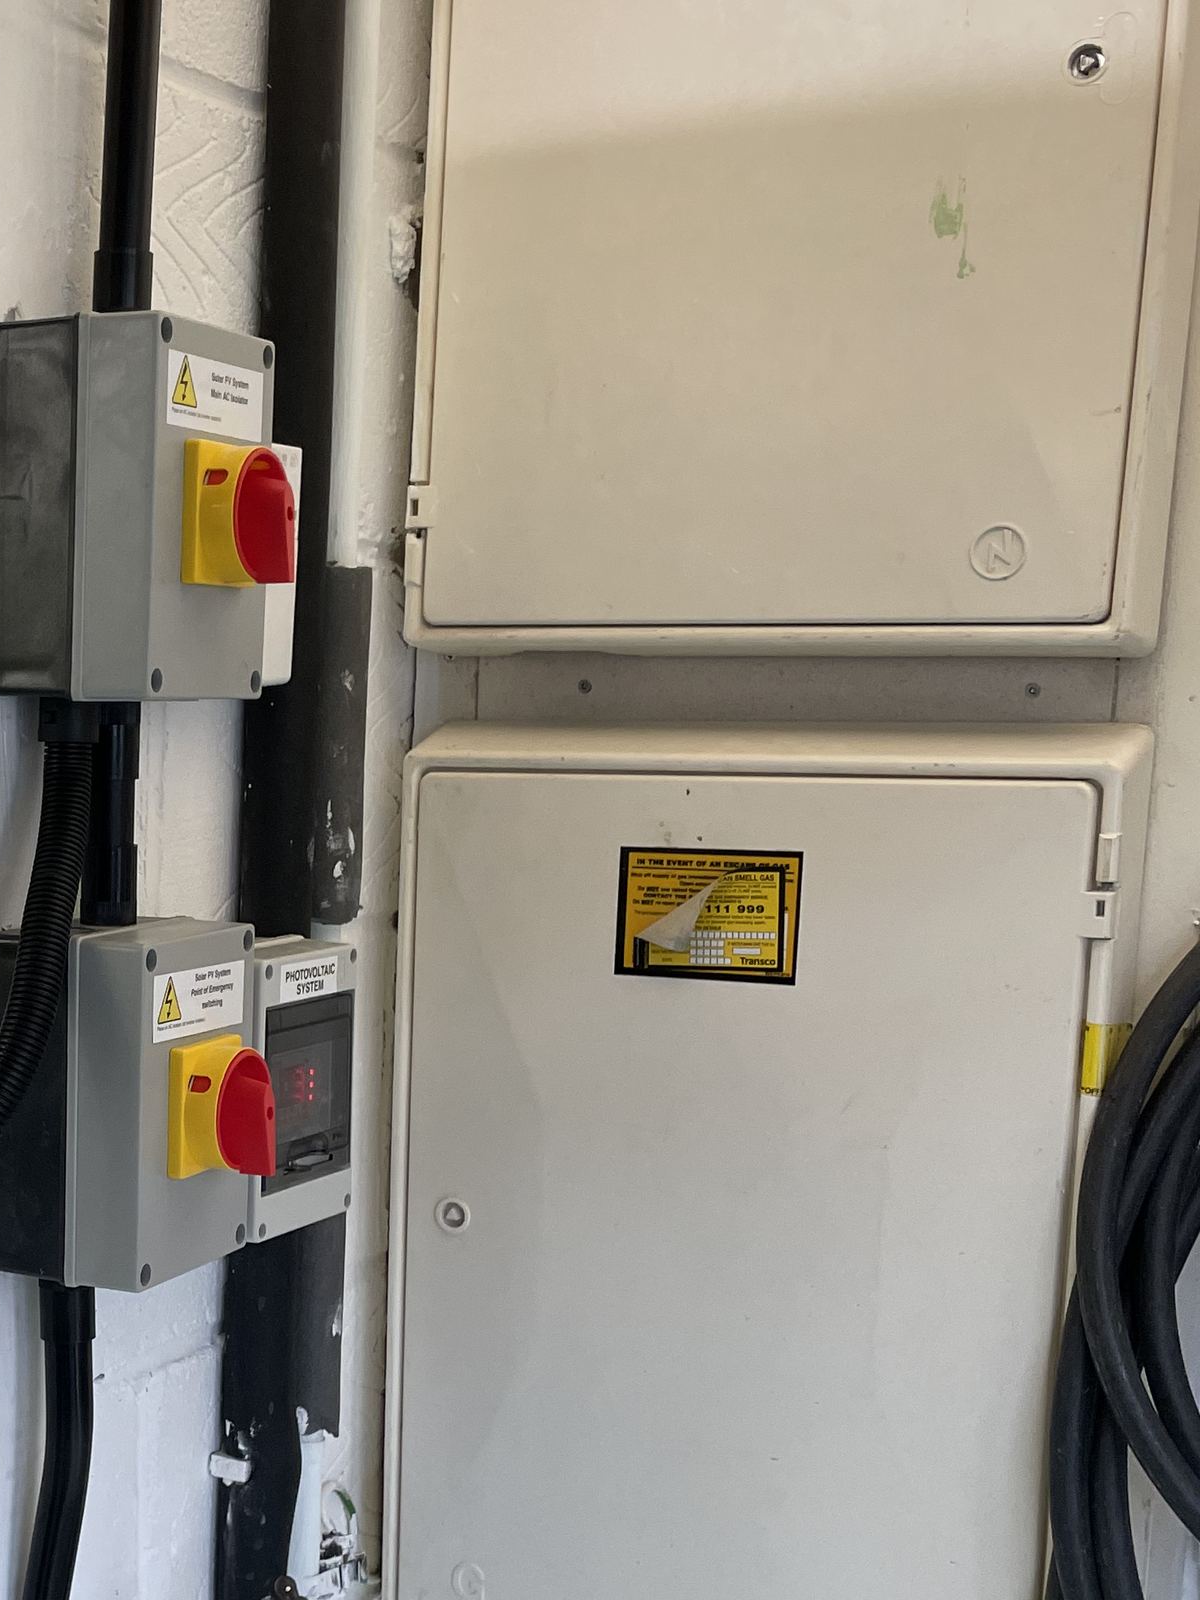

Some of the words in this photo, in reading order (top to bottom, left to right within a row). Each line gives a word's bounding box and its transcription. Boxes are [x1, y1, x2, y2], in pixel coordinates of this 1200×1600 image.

[737, 904, 764, 914] 999
[740, 956, 776, 966] Transco
[215, 968, 232, 980] System
[285, 963, 336, 983] PHOTOVOLTAIC
[208, 982, 234, 994] Emergency
[296, 979, 324, 996] SYSTEM
